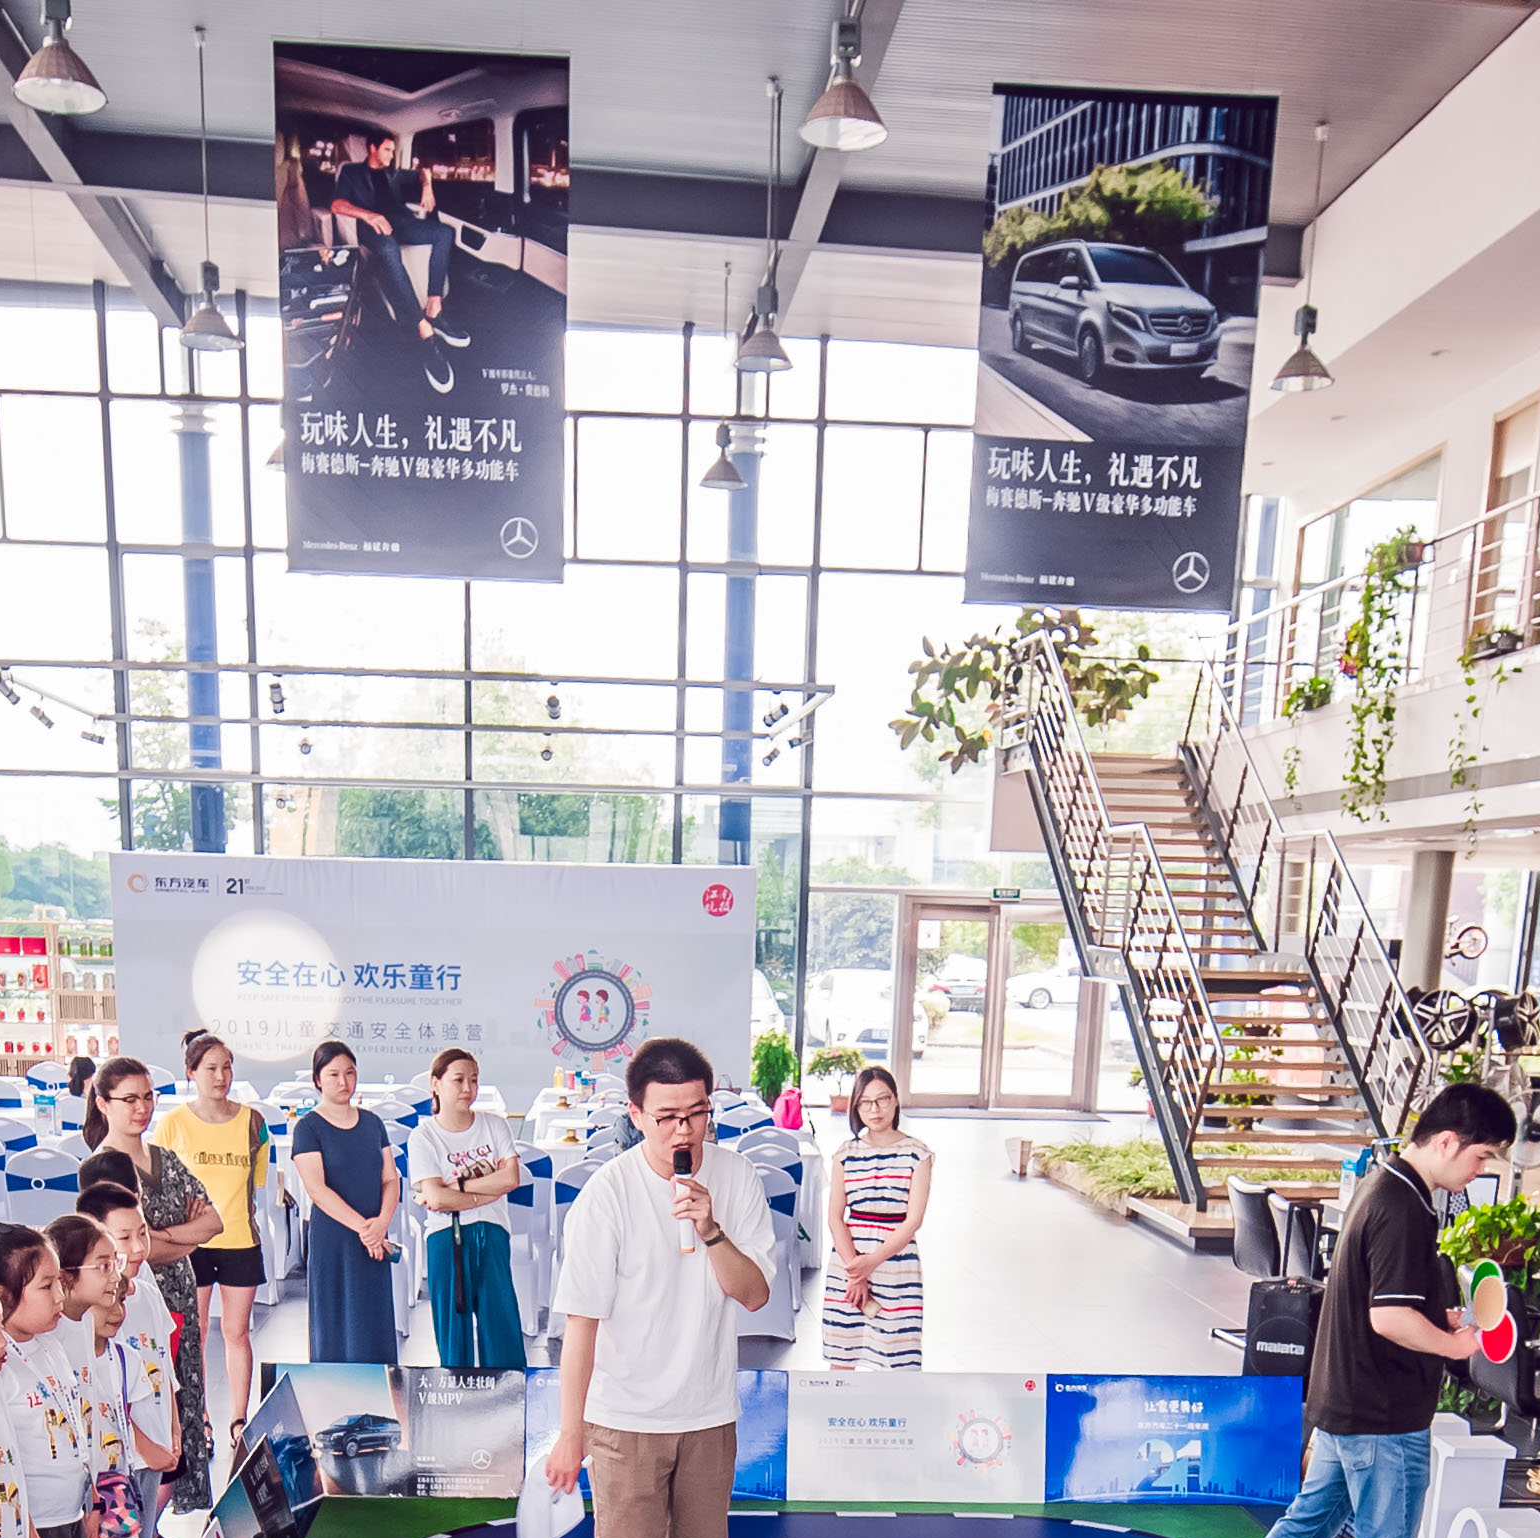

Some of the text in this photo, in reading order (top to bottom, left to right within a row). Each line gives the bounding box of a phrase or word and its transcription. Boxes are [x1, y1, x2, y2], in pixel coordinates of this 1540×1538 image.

[300, 411, 522, 454] 玩味人生，礼遇不凡
[987, 445, 1203, 490] 玩味人生，礼遇不凡
[237, 959, 462, 991] 安全在心 欢乐童行
